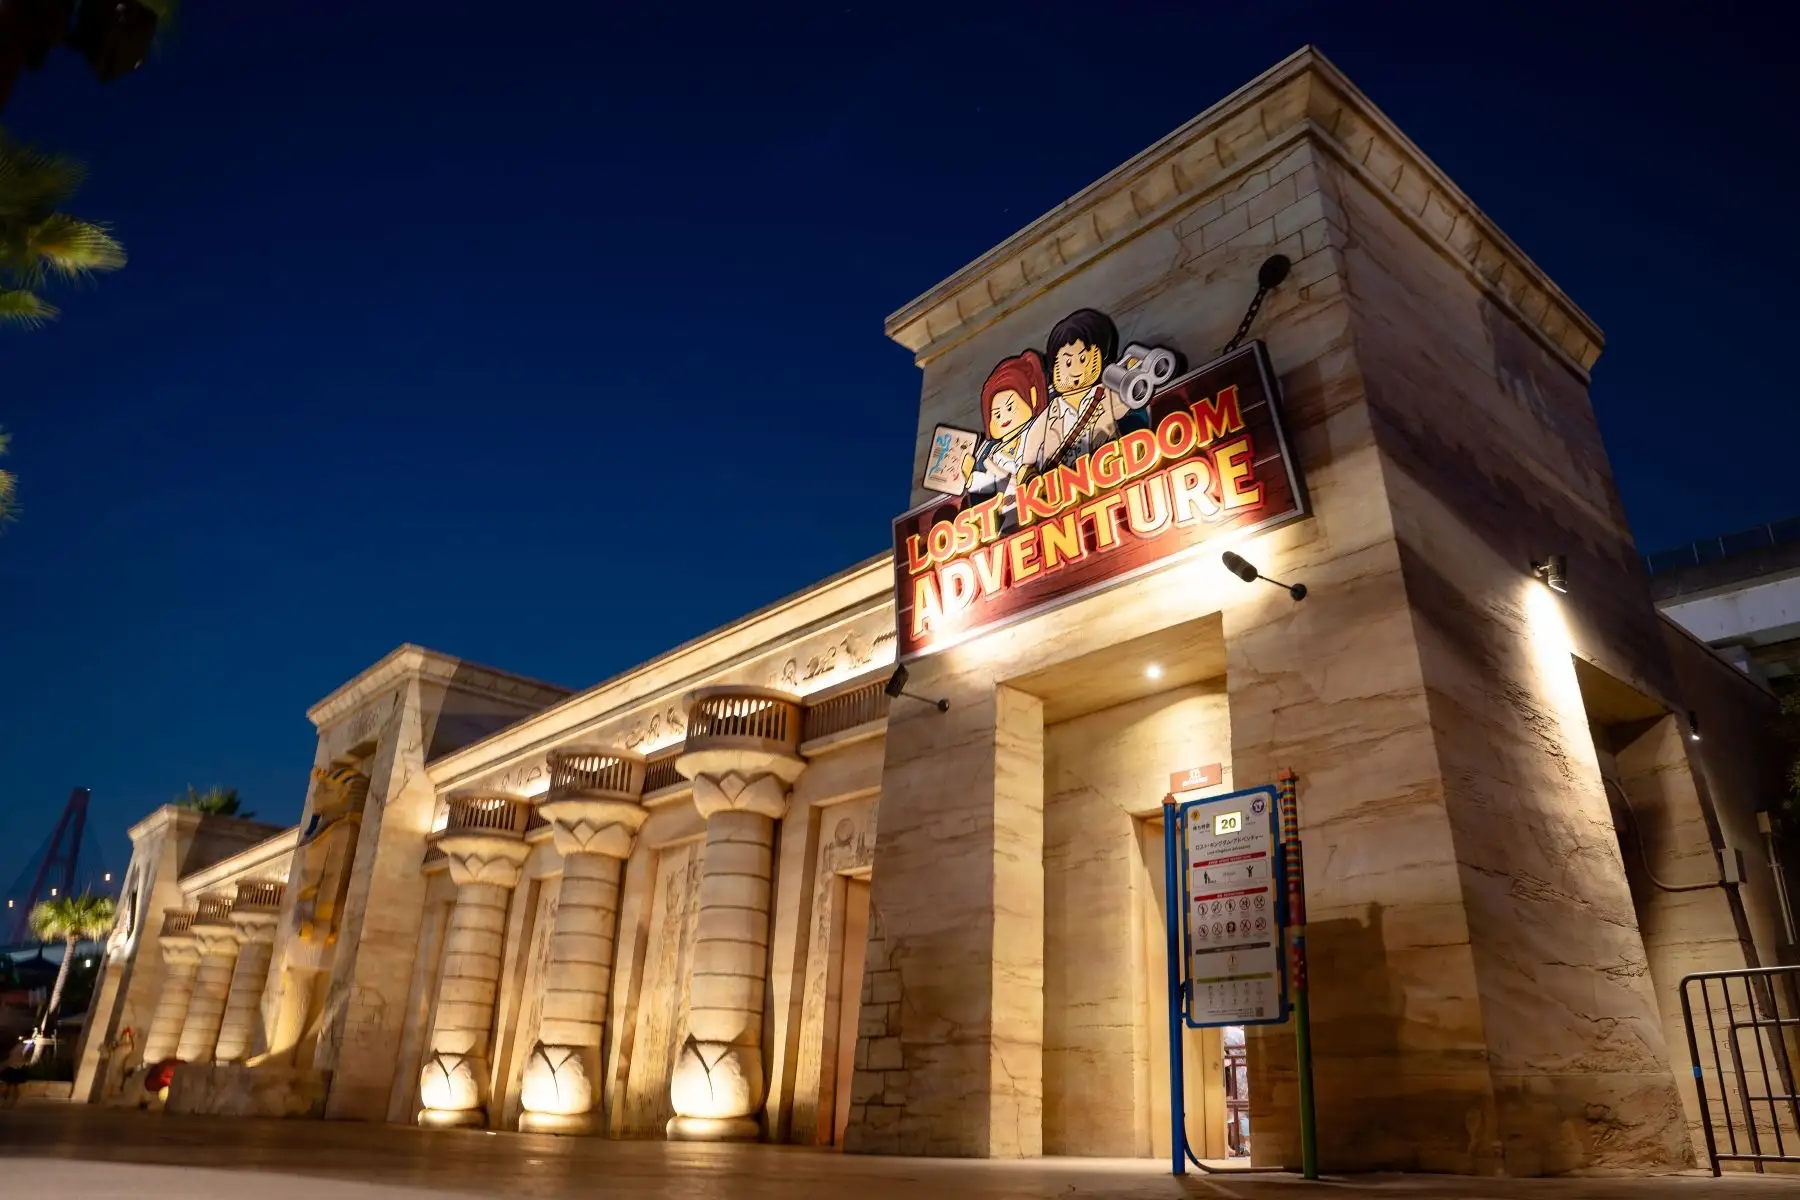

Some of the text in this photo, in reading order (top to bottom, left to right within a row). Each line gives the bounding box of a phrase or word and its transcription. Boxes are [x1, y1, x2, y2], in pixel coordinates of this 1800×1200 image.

[906, 385, 1246, 574] LOST KINGDOM
[910, 433, 1264, 642] ADVENTURE
[1221, 817, 1236, 829] 20
